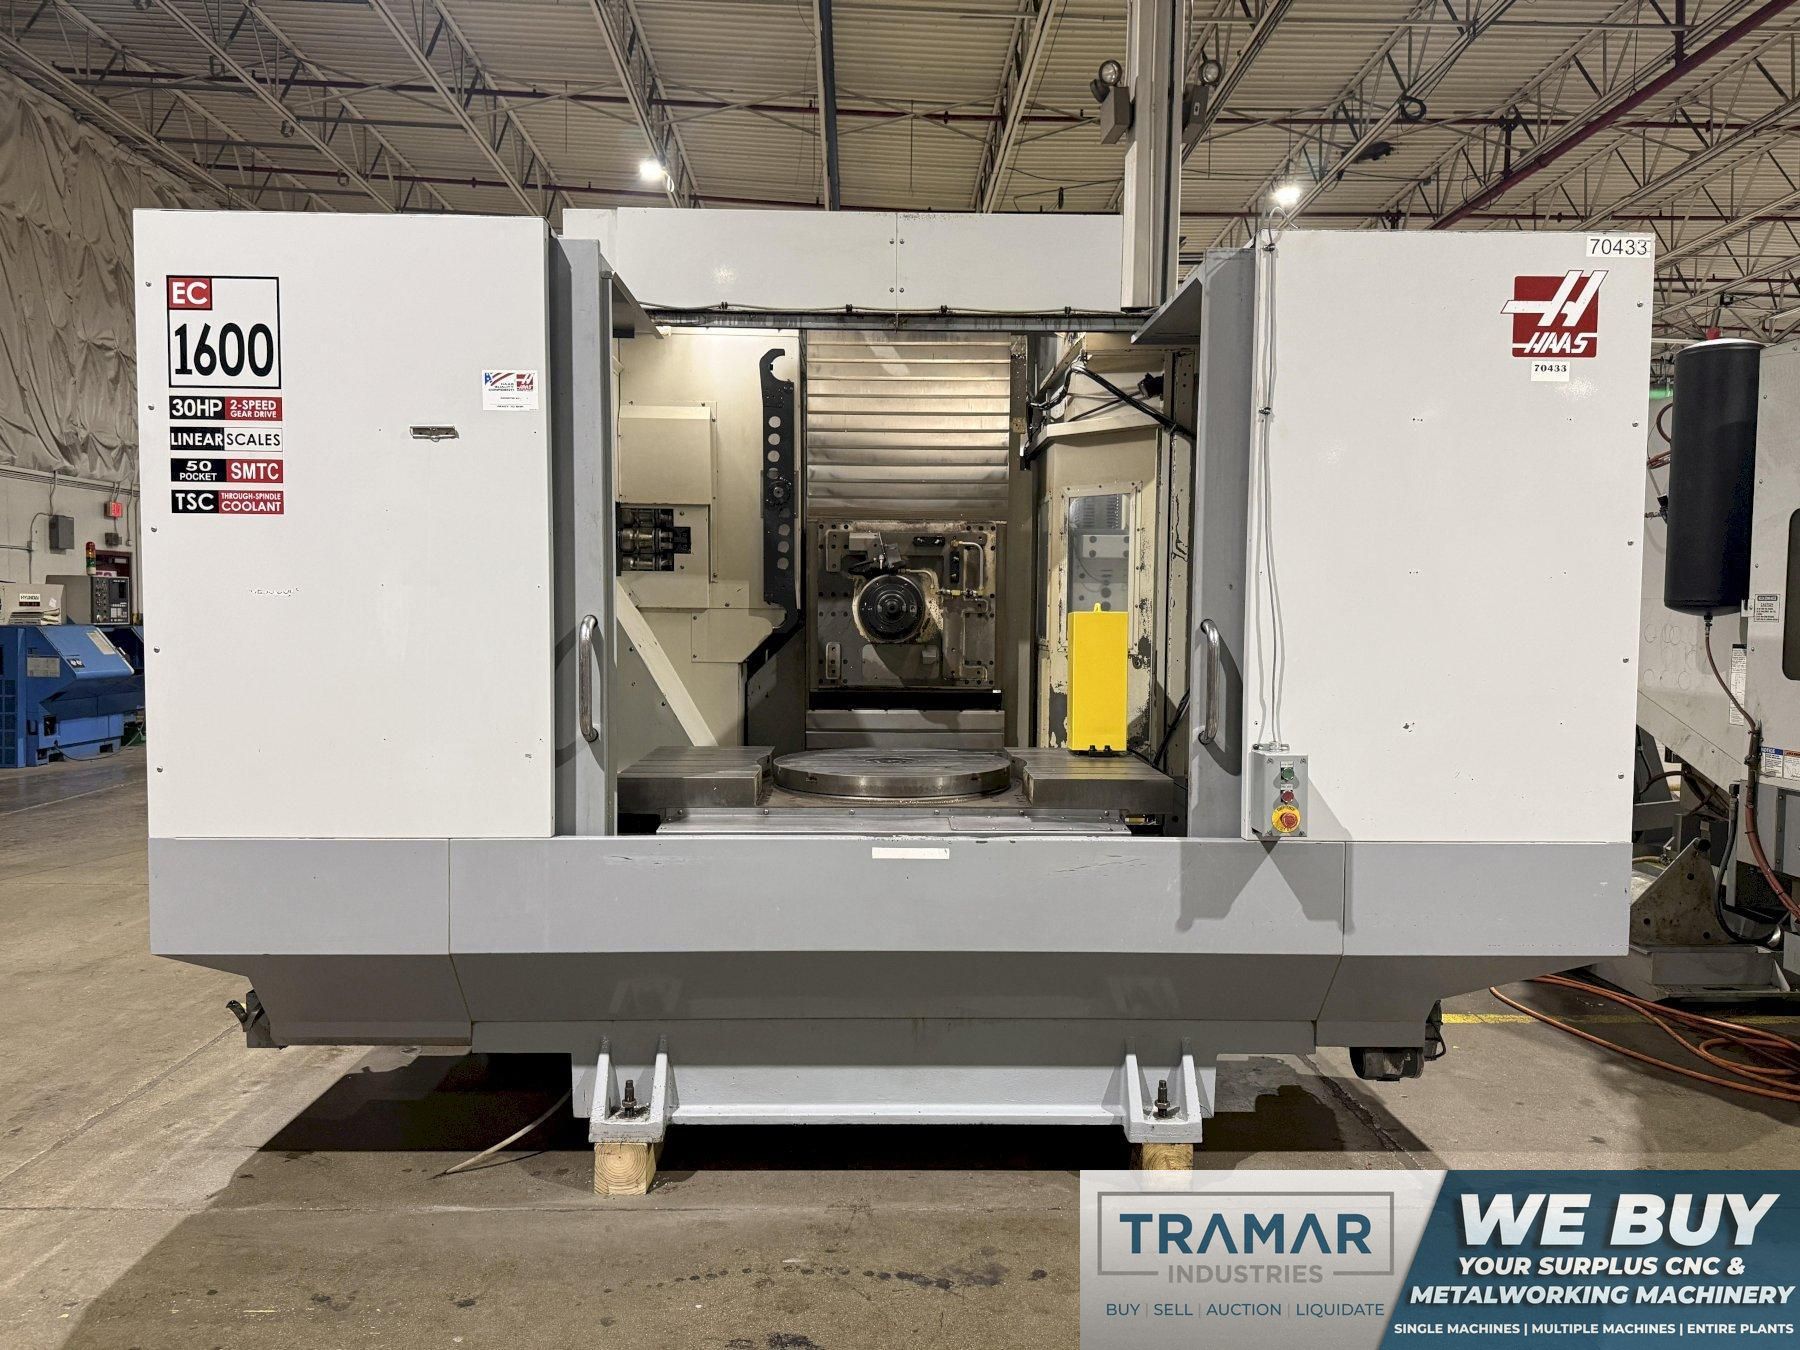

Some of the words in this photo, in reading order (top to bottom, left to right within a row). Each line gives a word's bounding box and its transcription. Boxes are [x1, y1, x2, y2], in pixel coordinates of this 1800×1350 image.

[1590, 238, 1648, 256] 70433
[172, 281, 208, 305] EC
[174, 322, 274, 377] 1600
[1513, 331, 1598, 354] HAAS
[1533, 364, 1568, 373] 70433
[171, 398, 223, 417] 30HP
[230, 399, 277, 411] 2-SPEED
[230, 410, 252, 418] GEAR
[170, 432, 223, 446] LINEAR
[226, 433, 281, 447] SCALES
[185, 460, 212, 472] 50
[231, 462, 280, 480] SMTC
[179, 472, 217, 481] POCKET
[175, 492, 214, 511] TSC
[221, 492, 281, 500] THROUGH-SPINDLE
[221, 501, 281, 512] COOLANT
